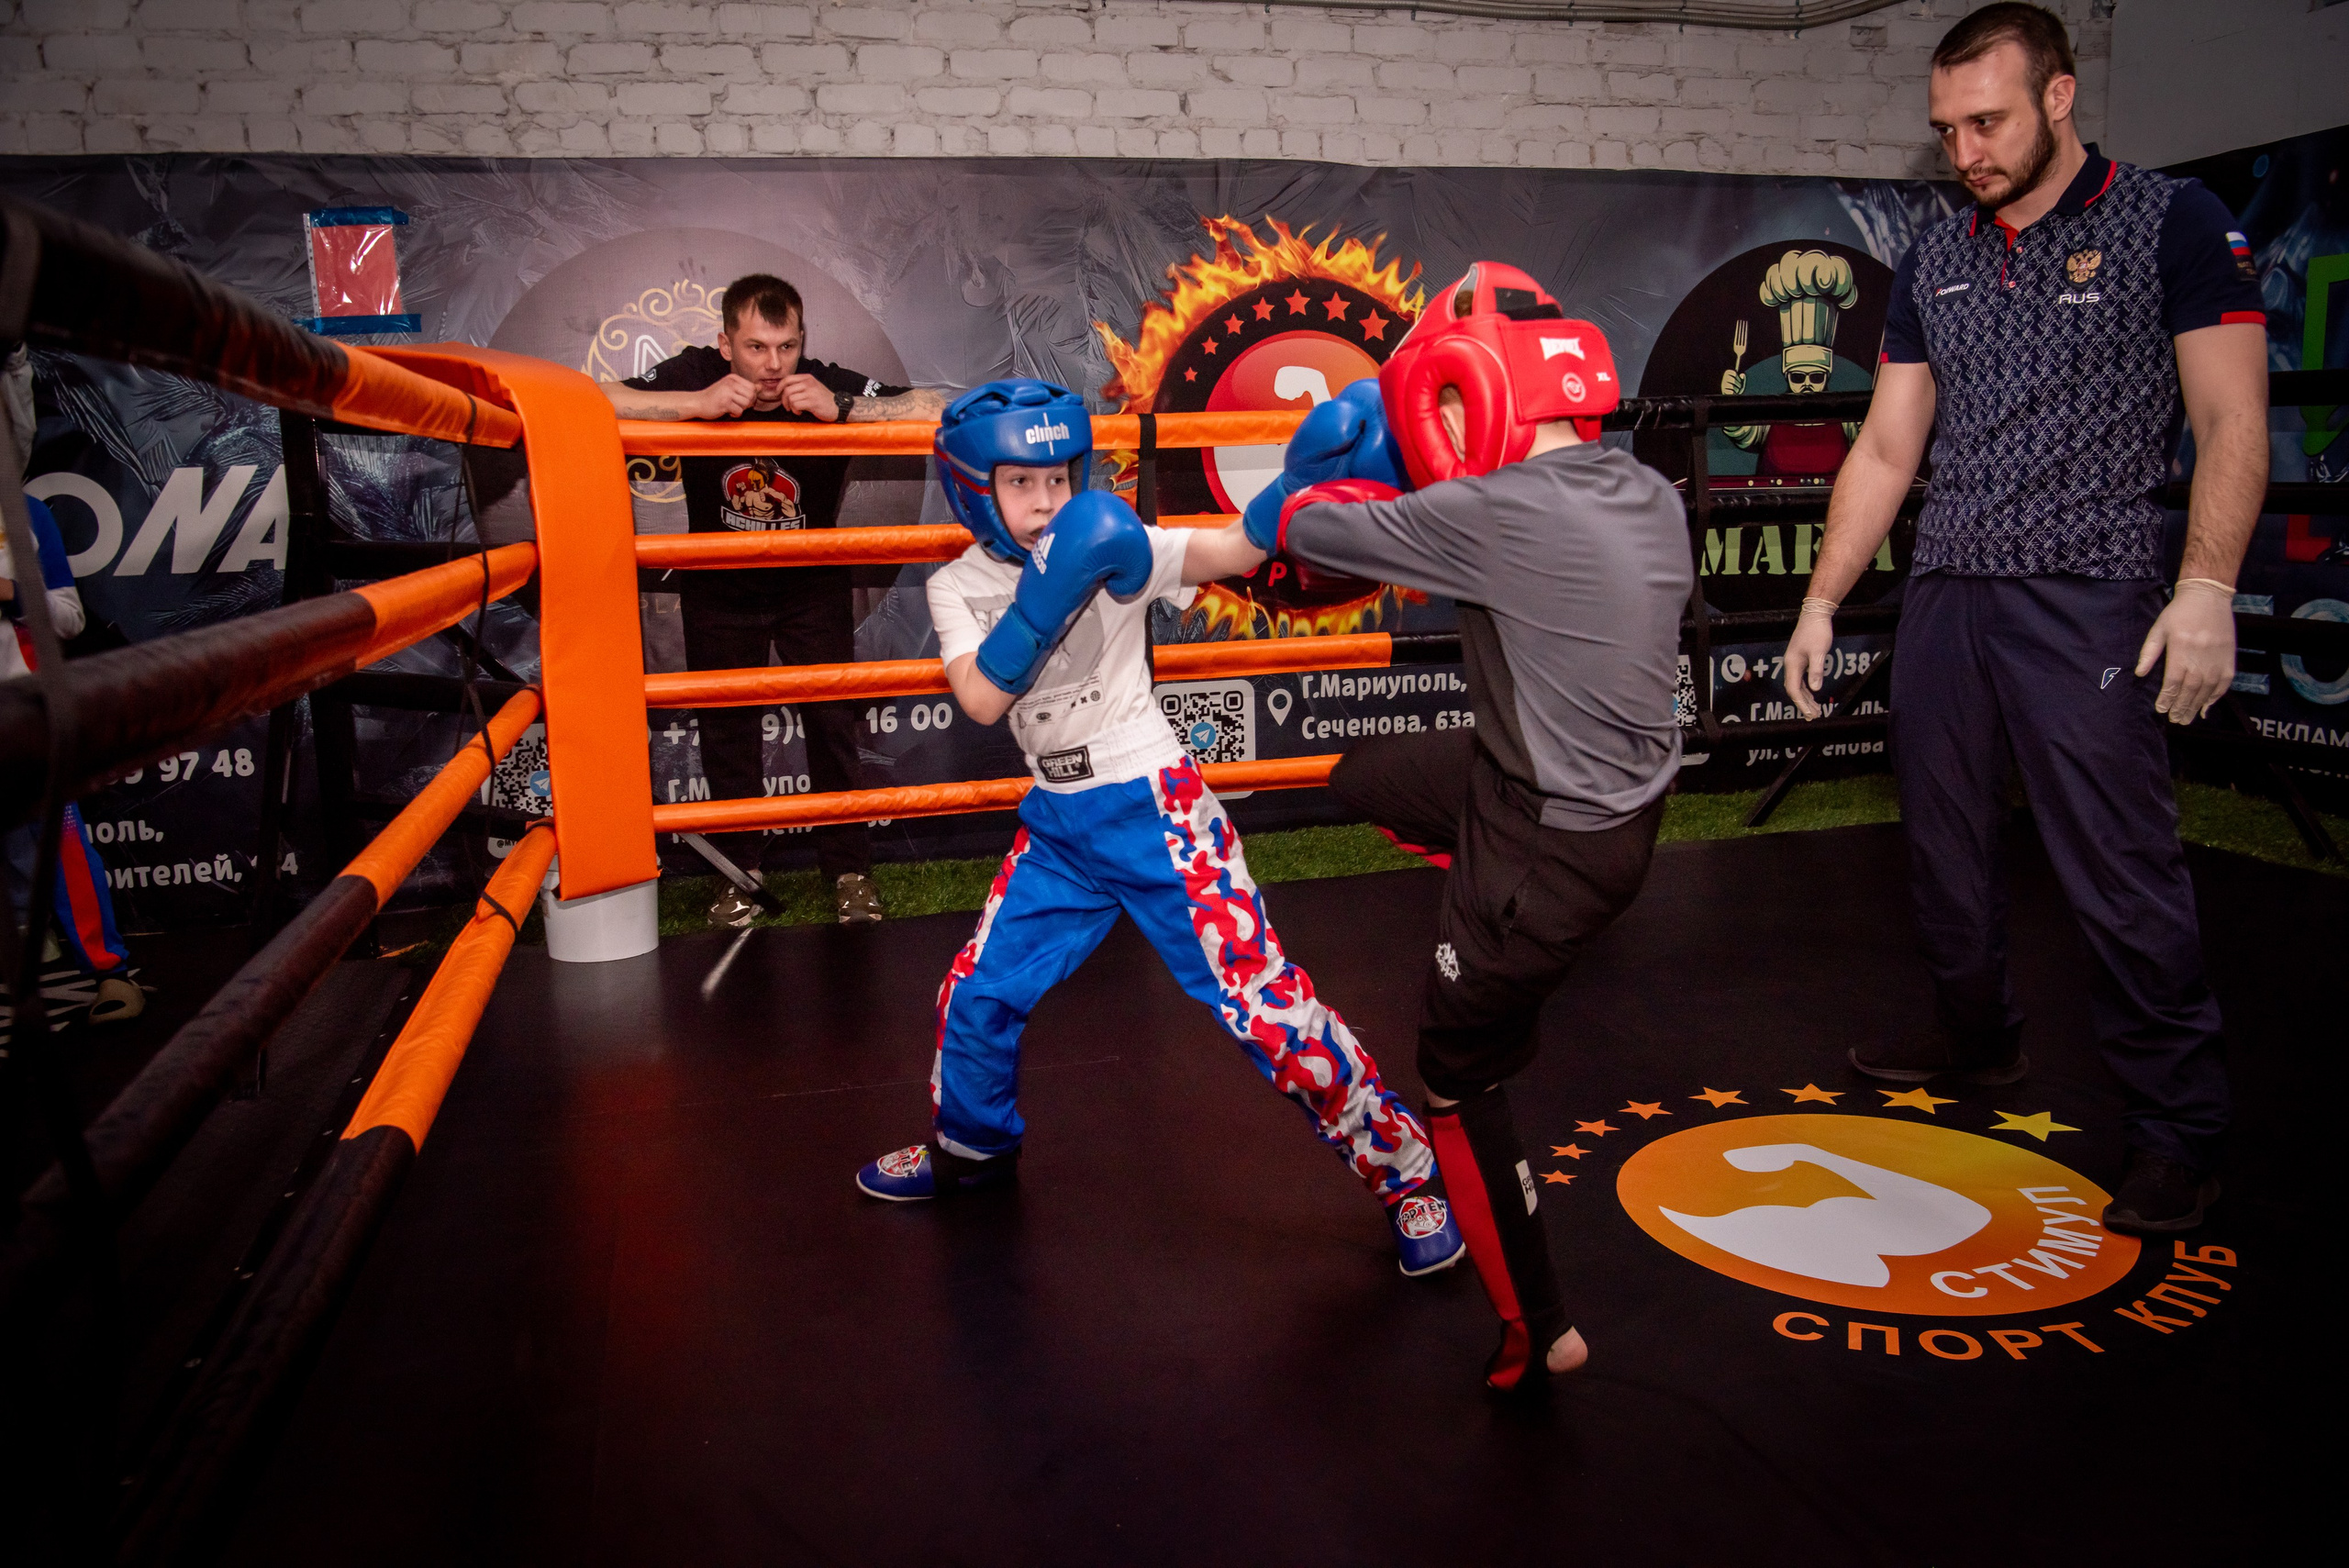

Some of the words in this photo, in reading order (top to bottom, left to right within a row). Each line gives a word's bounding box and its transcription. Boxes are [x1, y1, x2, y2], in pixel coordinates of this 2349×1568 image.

[2059, 293, 2101, 305] RUS
[1025, 422, 1070, 445] clinch
[1302, 672, 1467, 701] Г.Мариуполь,
[865, 706, 898, 734] 16
[1301, 715, 1428, 740] Сеченова,
[158, 751, 200, 782] 97
[212, 748, 255, 779] 48
[1041, 753, 1083, 770] GREEN
[1046, 766, 1080, 778] HILL
[1930, 1185, 2105, 1299] СТИМУЛ
[1772, 1310, 2107, 1362] СПОРТ
[2112, 1239, 2239, 1336] КЛУБ
